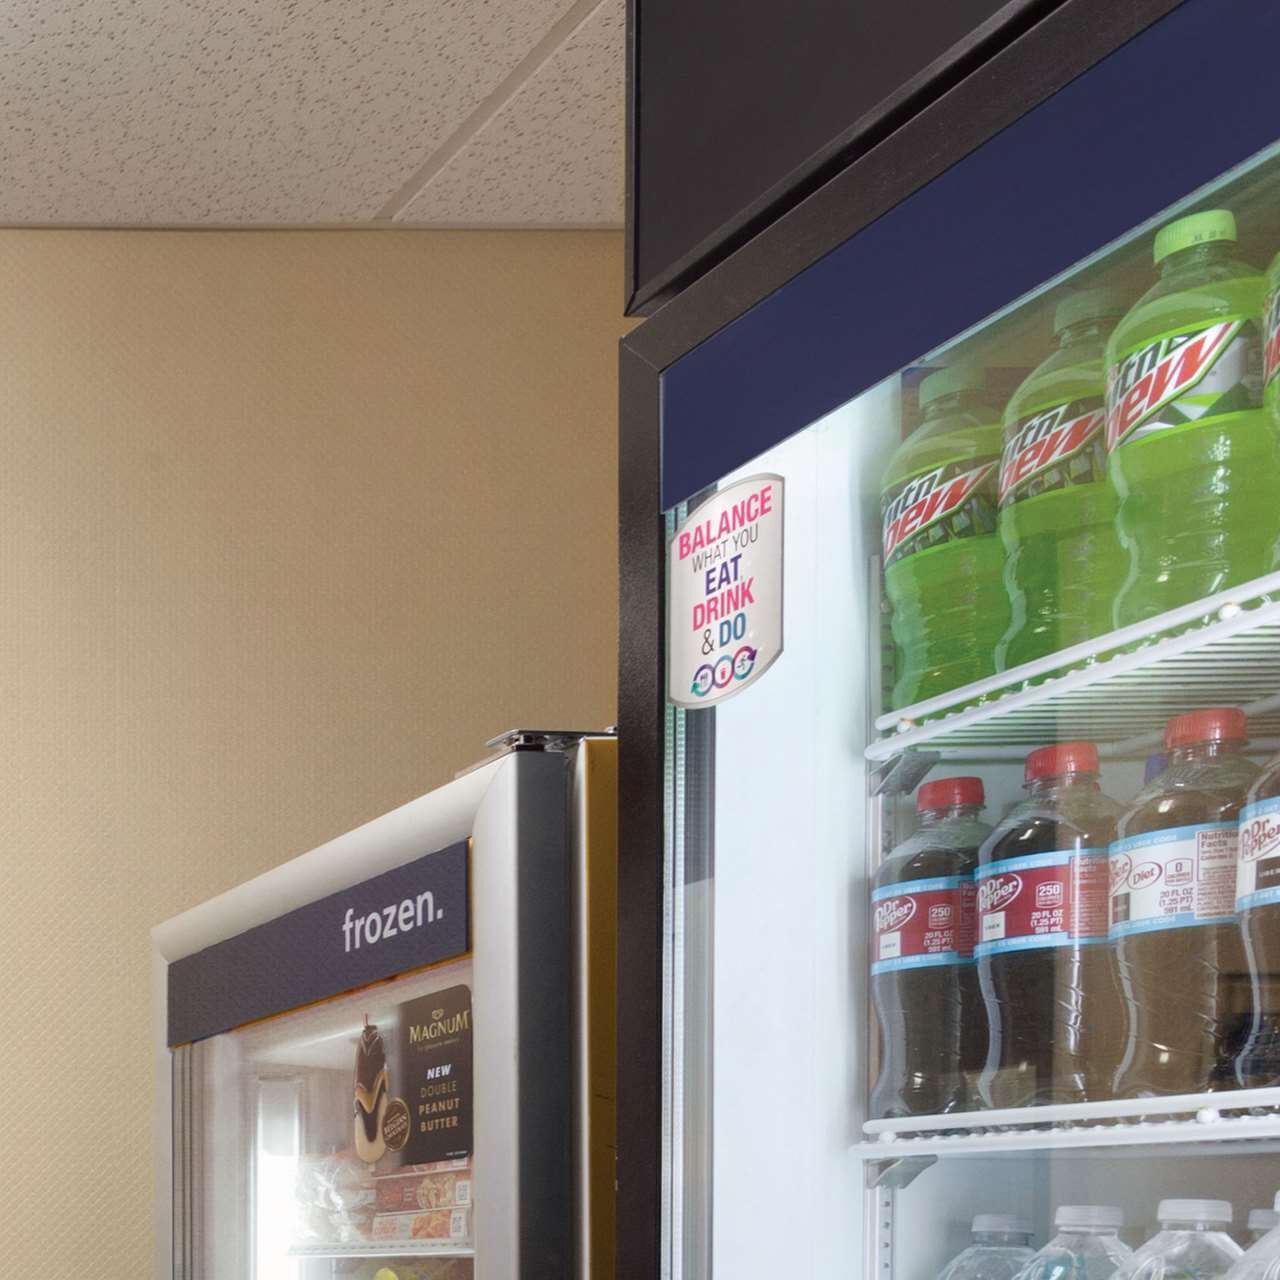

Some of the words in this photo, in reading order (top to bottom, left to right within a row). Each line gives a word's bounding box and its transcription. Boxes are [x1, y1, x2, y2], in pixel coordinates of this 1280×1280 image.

[679, 486, 772, 560] BALANCE
[693, 539, 728, 573] WHAT
[733, 522, 758, 551] YOU
[705, 554, 741, 596] EAT
[693, 577, 754, 631] DRINK
[701, 628, 715, 655] &
[719, 613, 746, 648] DO
[1201, 840, 1228, 848] Facts
[1132, 867, 1155, 886] Diet
[1039, 884, 1061, 896] 250
[342, 890, 444, 952] frozen.
[931, 906, 952, 918] 250
[408, 1010, 471, 1045] MAGNUM
[427, 1063, 452, 1080] NEW
[420, 1080, 458, 1099] DOUBLE
[419, 1097, 460, 1116] PEANUT
[420, 1116, 459, 1133] BUTTER
